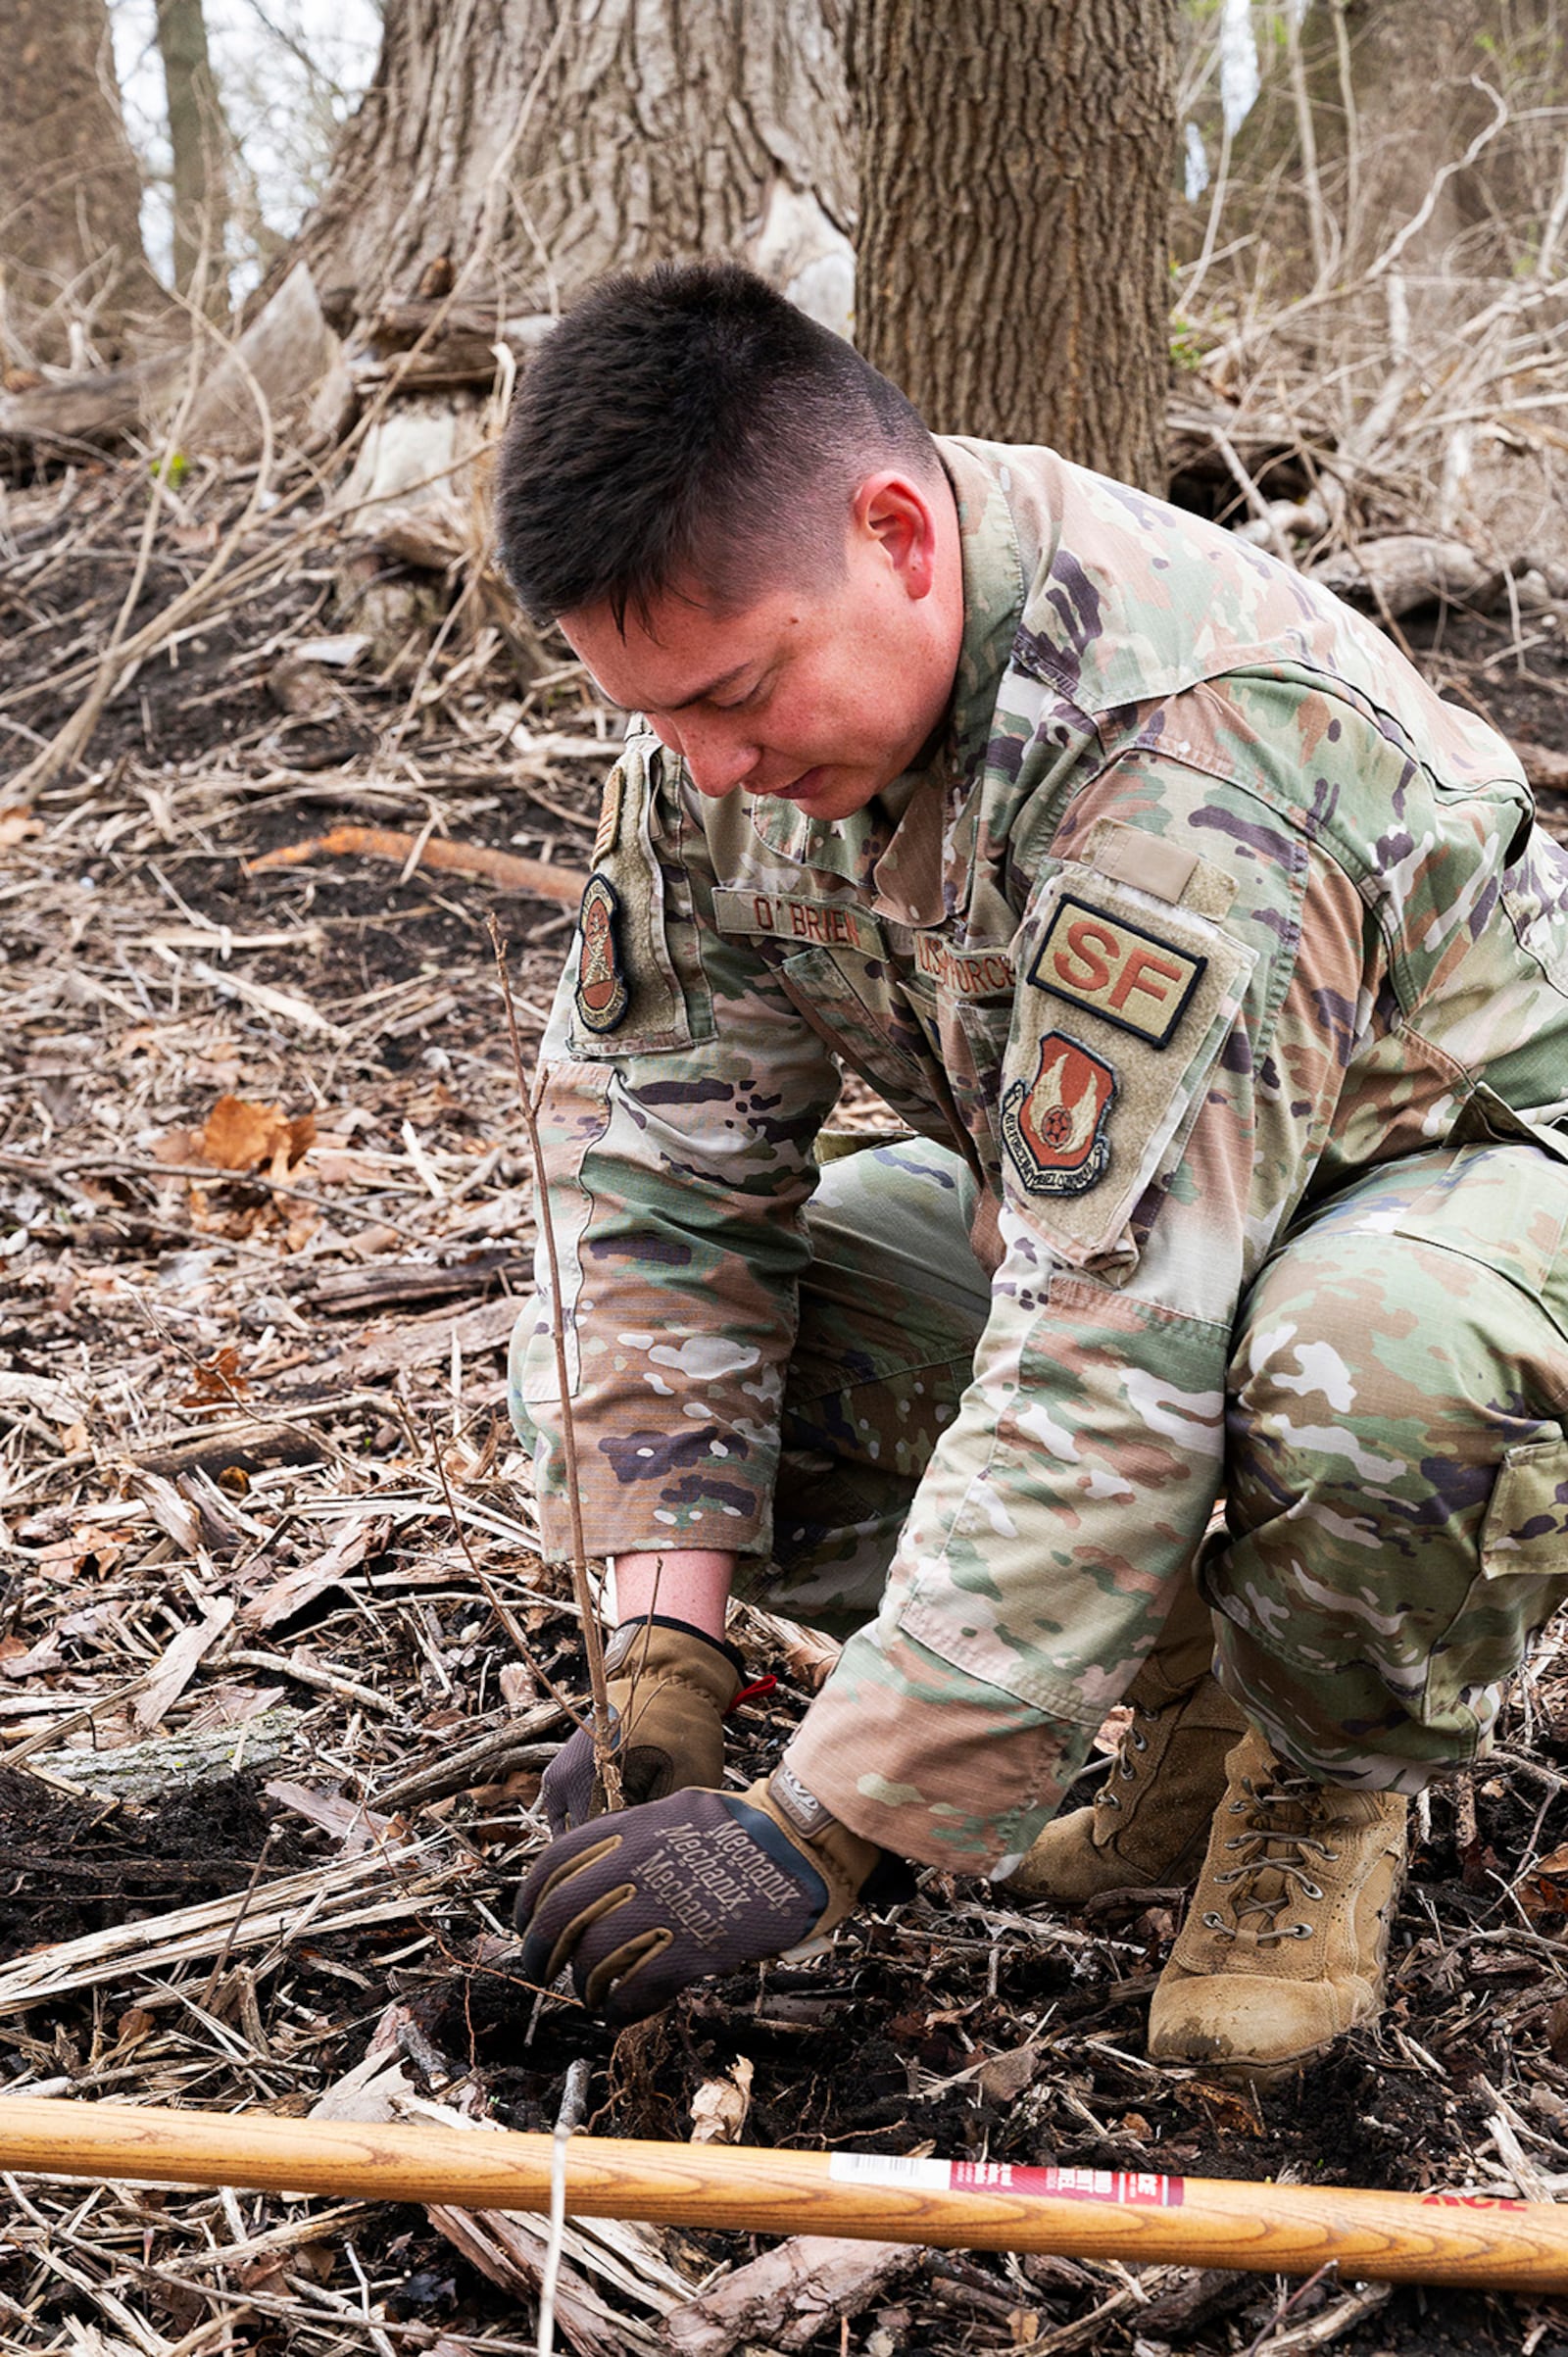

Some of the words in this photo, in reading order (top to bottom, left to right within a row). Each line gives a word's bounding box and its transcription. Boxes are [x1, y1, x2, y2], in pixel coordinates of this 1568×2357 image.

[755, 898, 861, 949] O'BRIEN
[1053, 920, 1183, 1010] SF
[634, 1850, 729, 1947] Mechanix
[657, 1822, 753, 1913] Mechanix
[707, 1819, 802, 1910] Mechanix
